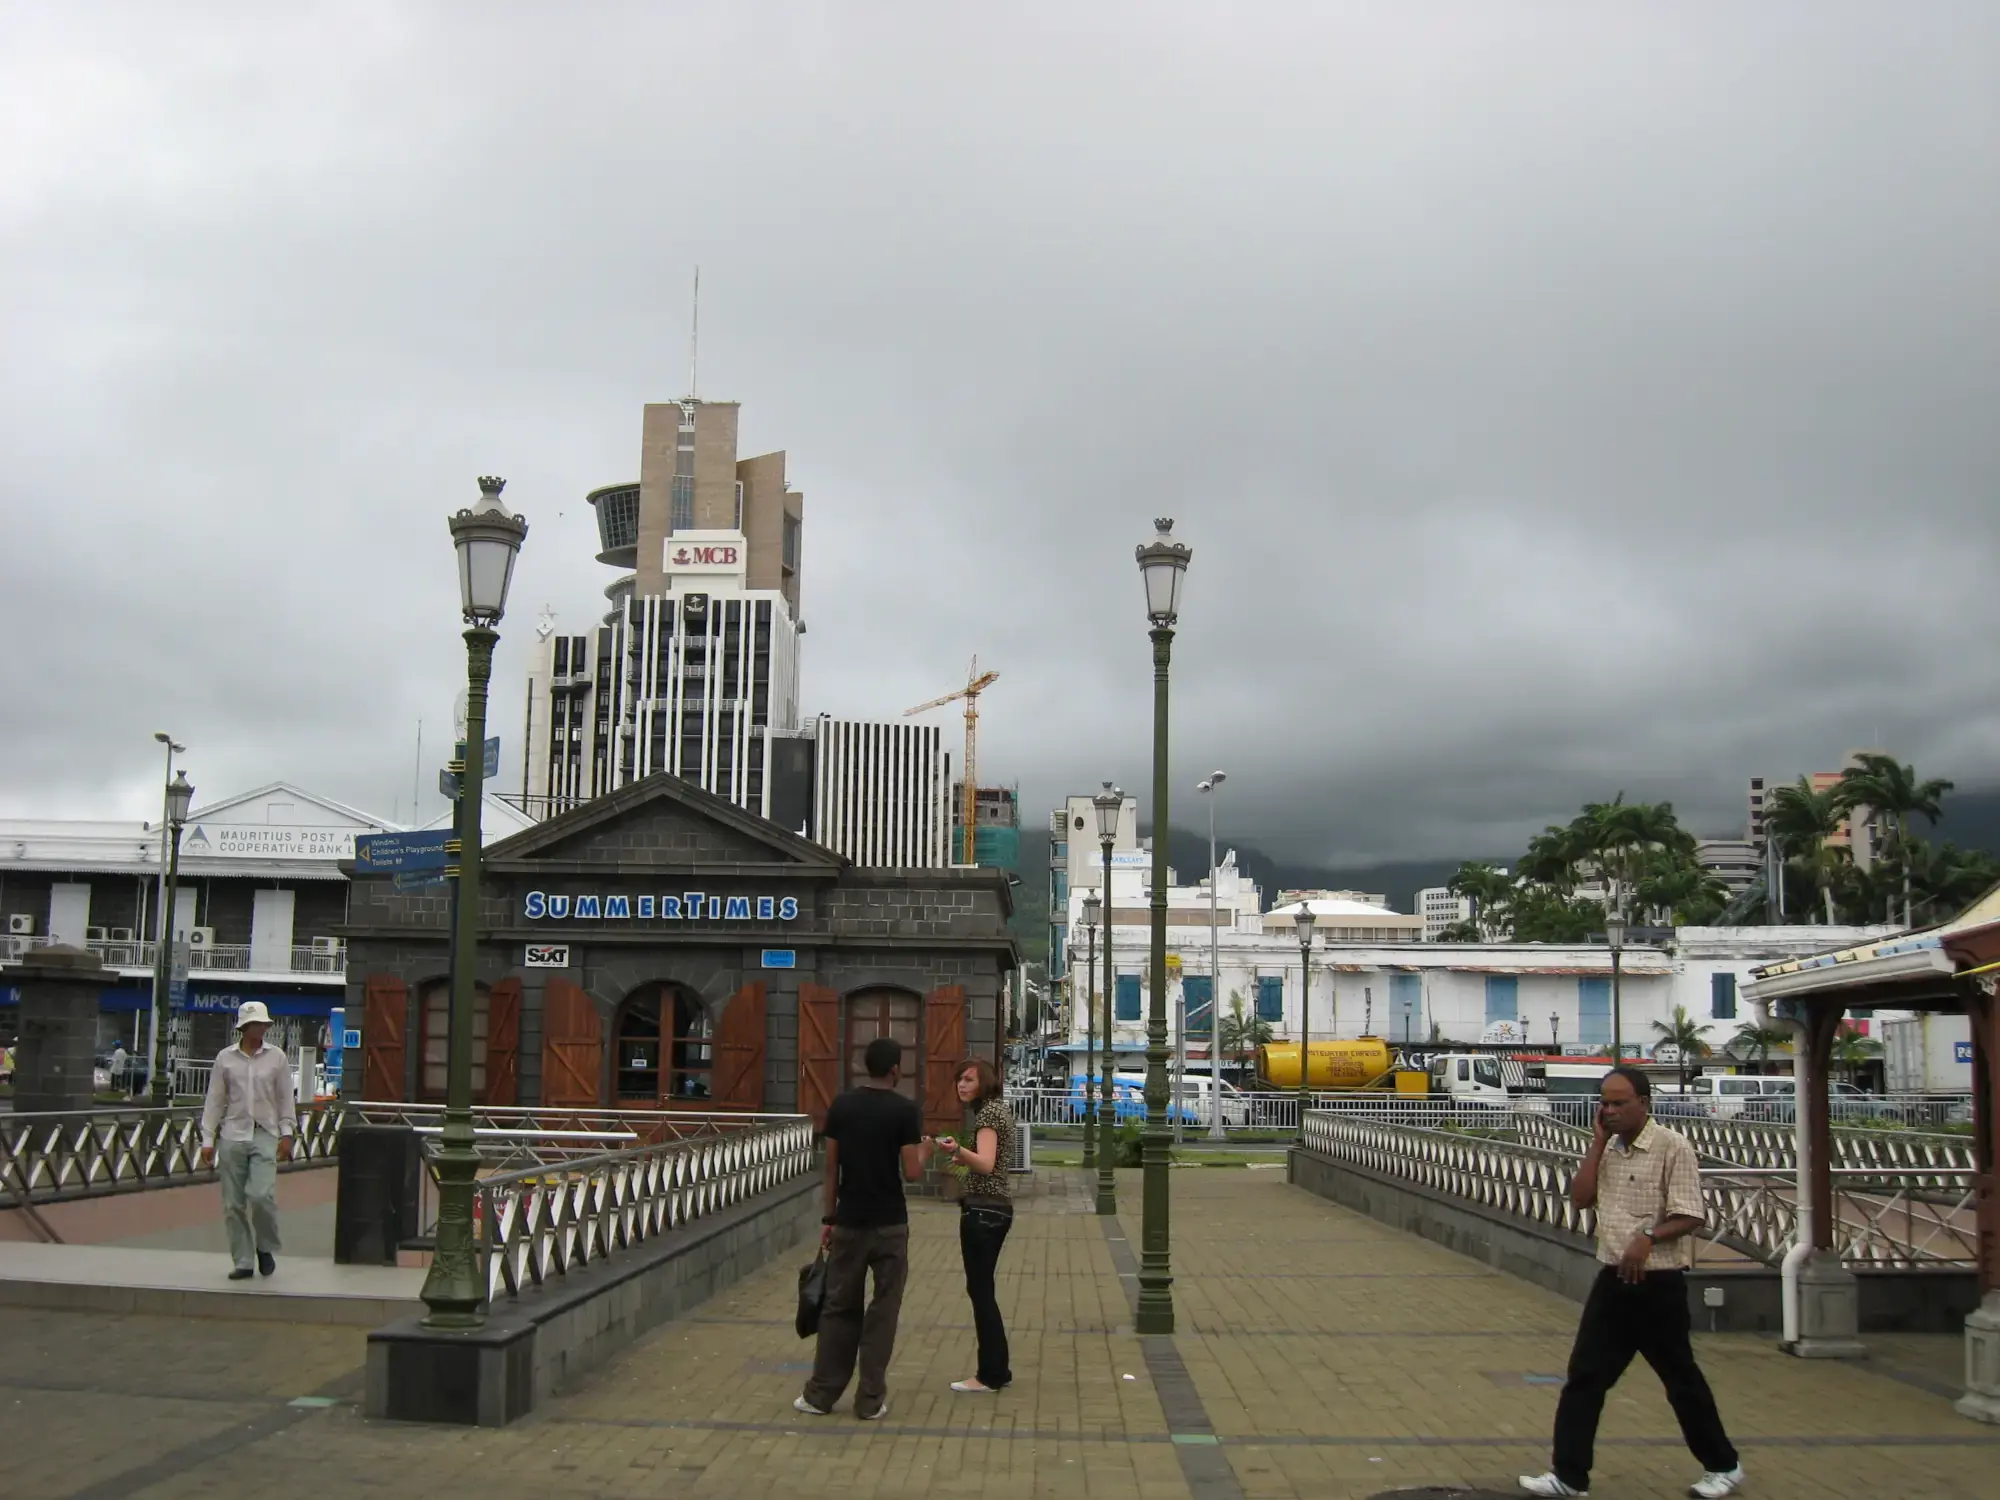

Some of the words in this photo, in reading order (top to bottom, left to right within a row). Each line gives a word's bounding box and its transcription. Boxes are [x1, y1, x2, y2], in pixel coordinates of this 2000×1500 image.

[692, 547, 737, 564] MCB
[220, 831, 292, 842] MAURITIUS
[301, 832, 335, 843] POST
[219, 842, 304, 853] COOPERATIVE
[309, 844, 342, 854] BANK
[405, 844, 443, 856] Playground
[193, 994, 240, 1009] MPCB
